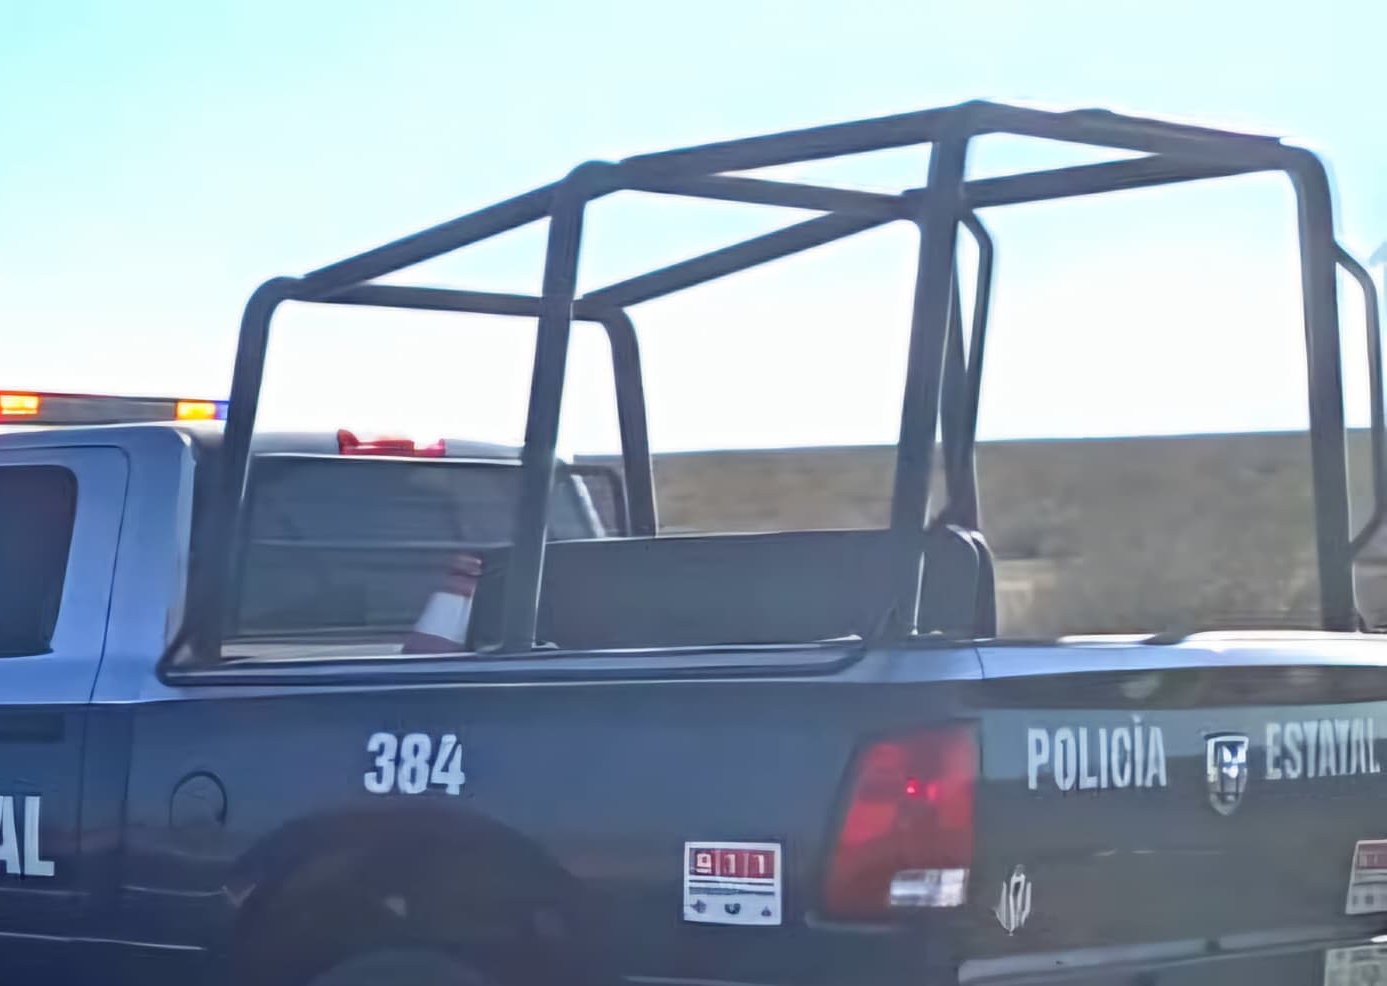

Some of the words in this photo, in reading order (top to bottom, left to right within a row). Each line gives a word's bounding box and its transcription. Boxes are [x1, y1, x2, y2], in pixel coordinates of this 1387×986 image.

[364, 732, 466, 795] 384
[1265, 718, 1380, 780] ESTATAL
[696, 853, 765, 874] 911
